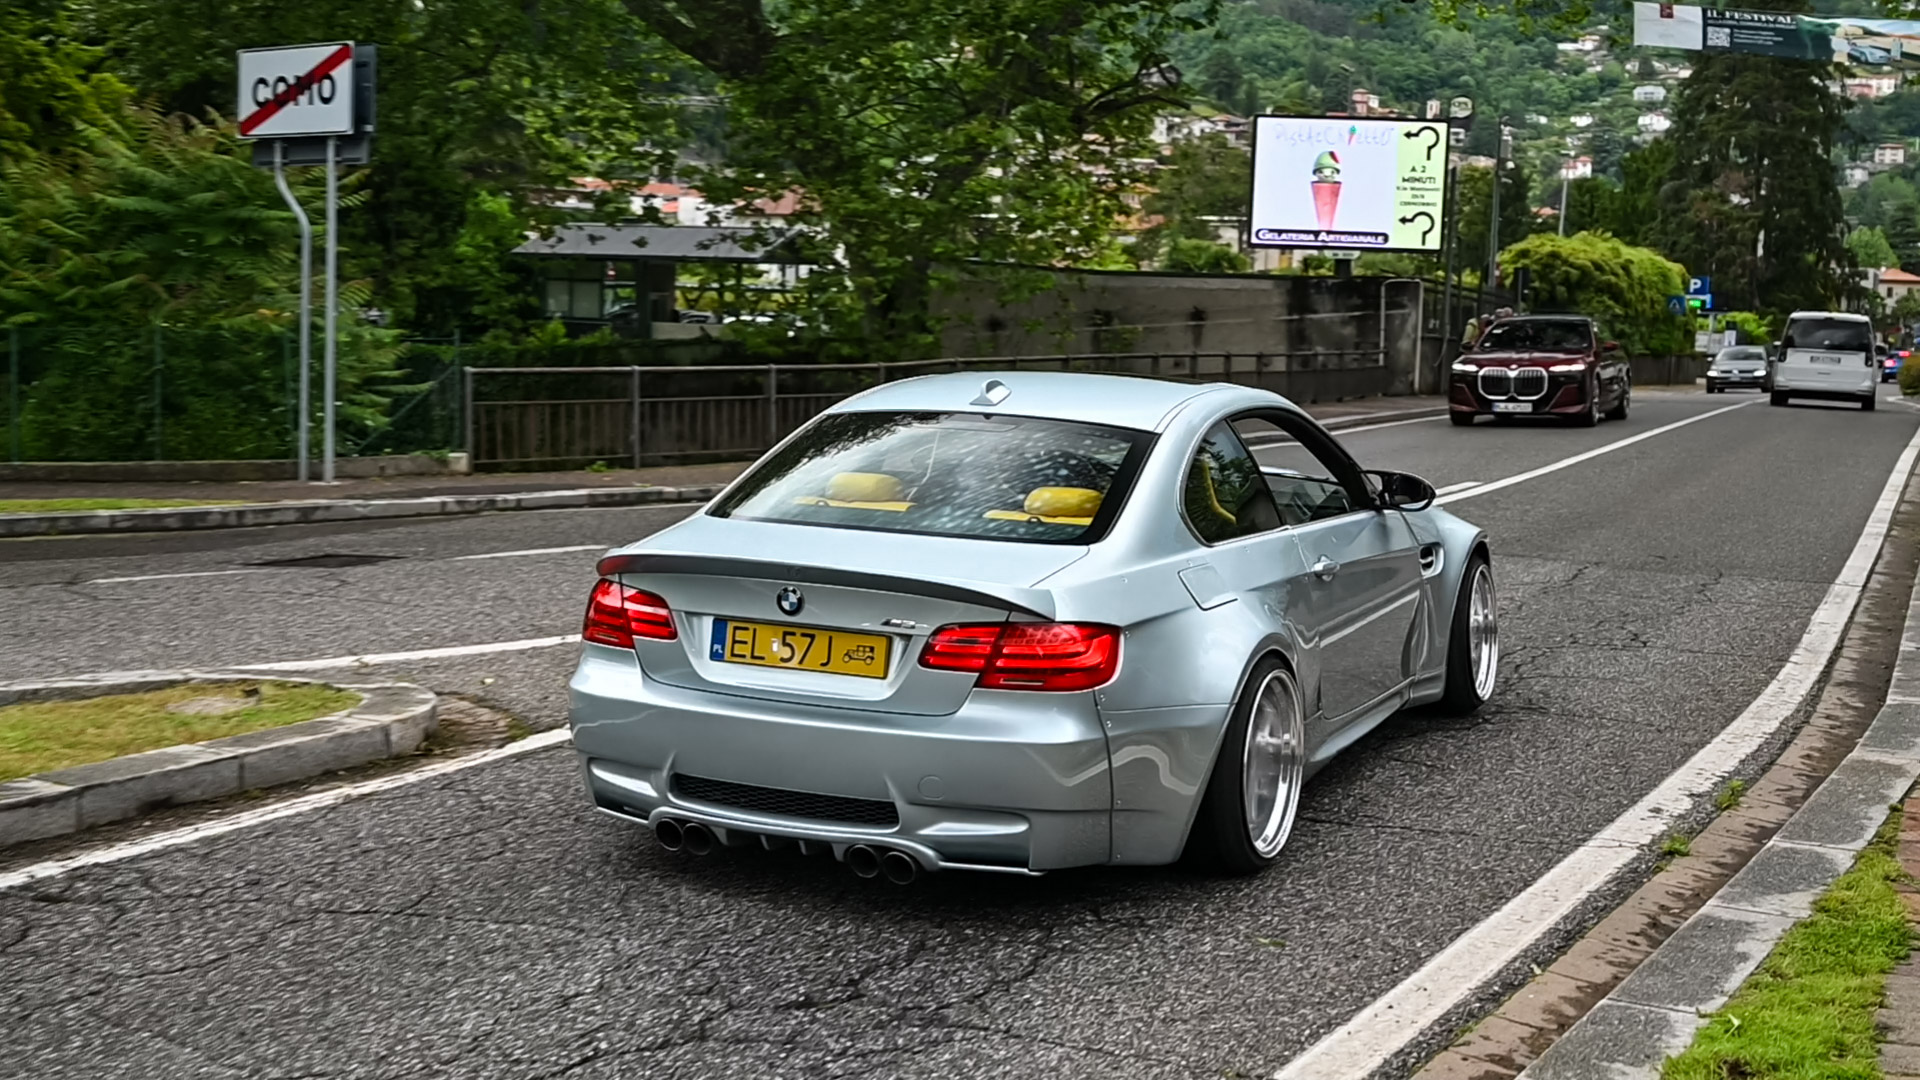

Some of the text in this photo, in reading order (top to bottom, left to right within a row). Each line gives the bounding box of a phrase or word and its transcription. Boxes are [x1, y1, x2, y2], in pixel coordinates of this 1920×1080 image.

[1706, 9, 1722, 18] IL
[1725, 10, 1797, 24] FESTIVAL
[251, 73, 336, 109] COMO
[1401, 176, 1436, 184] MINUTI
[1689, 278, 1702, 293] P
[730, 625, 766, 661] EL
